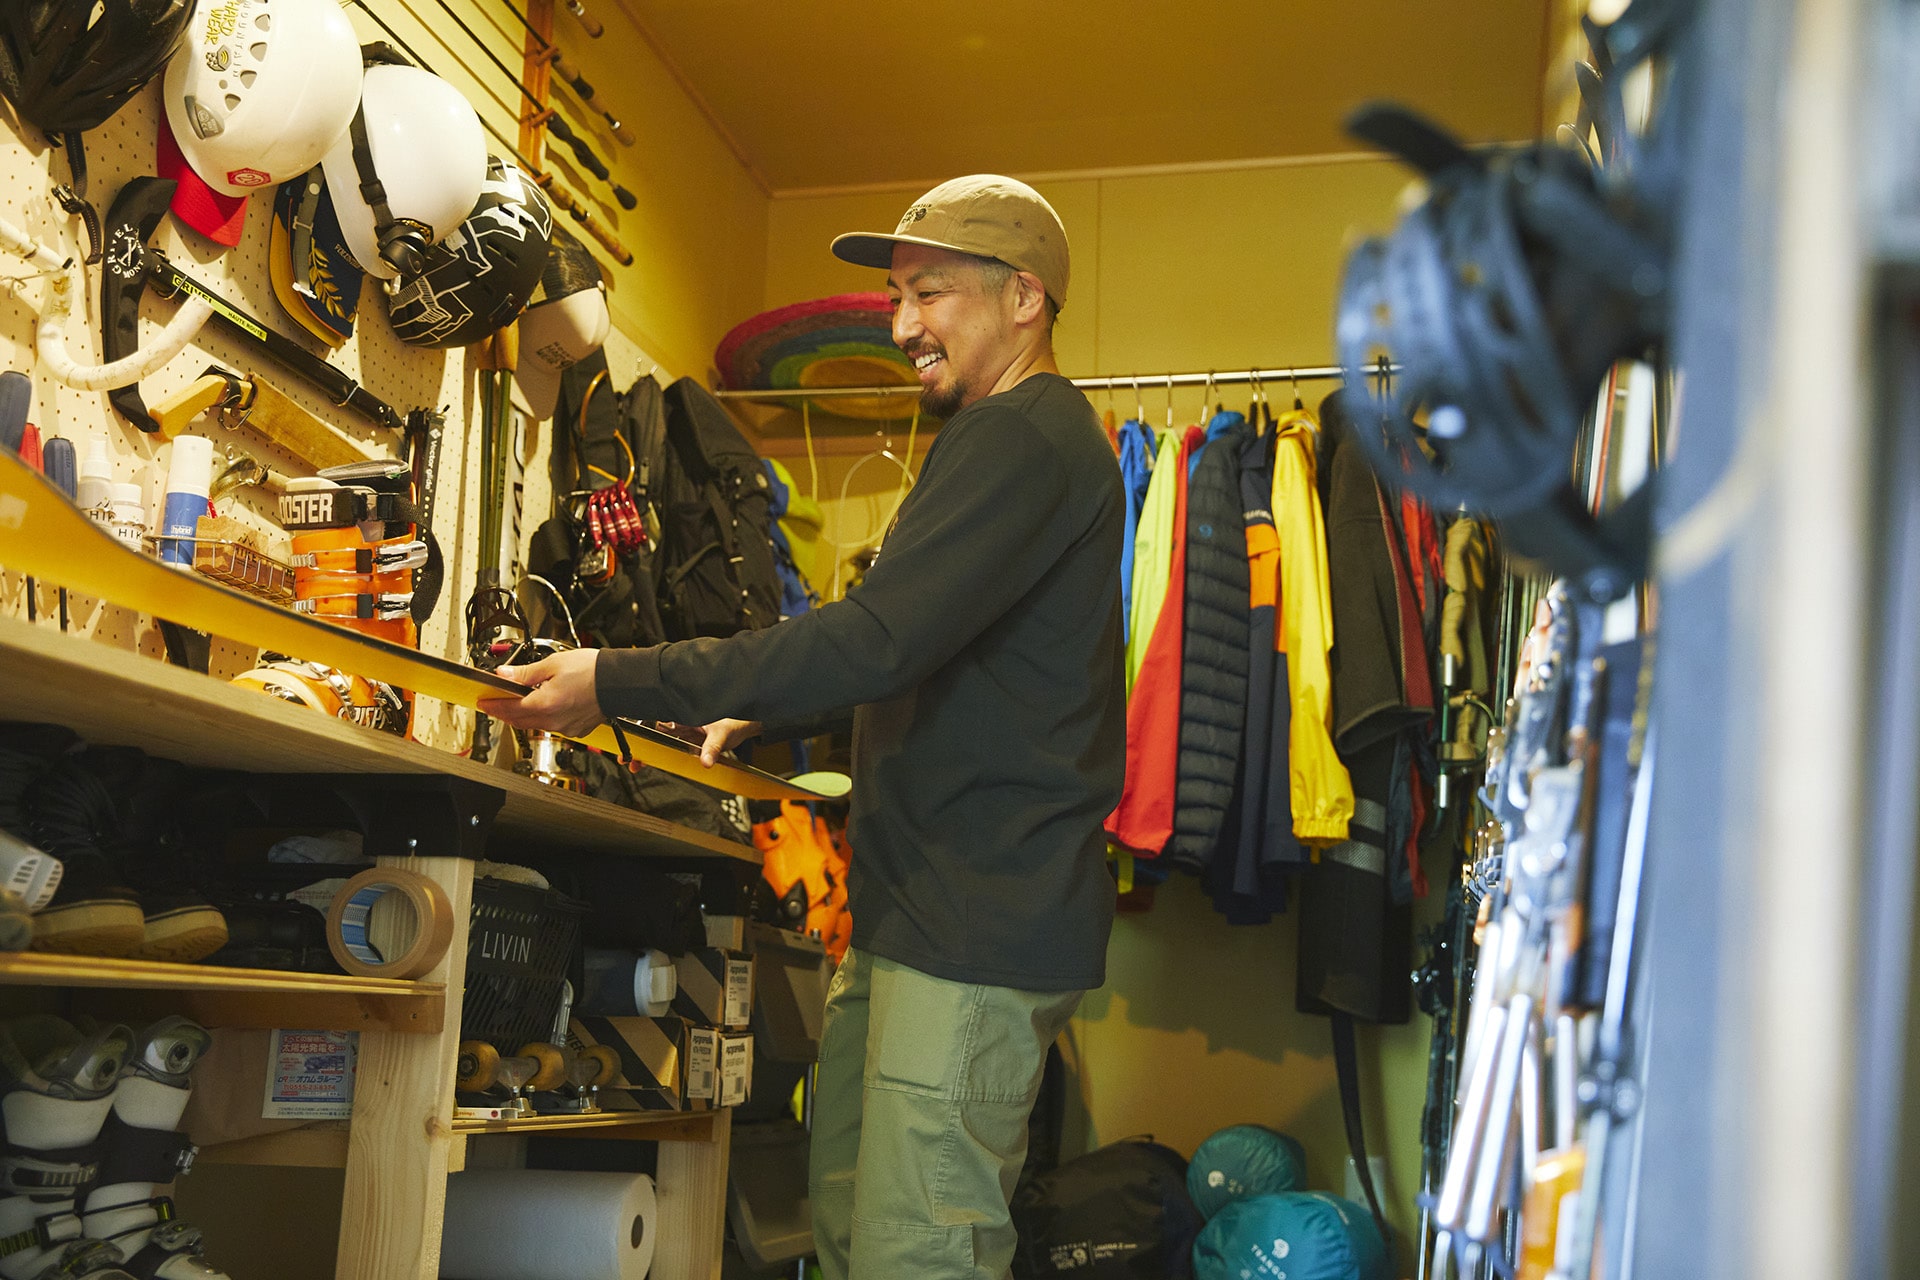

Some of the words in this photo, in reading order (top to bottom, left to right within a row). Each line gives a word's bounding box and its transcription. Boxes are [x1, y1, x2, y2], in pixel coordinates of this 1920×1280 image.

[203, 8, 224, 45] WEAR
[220, 0, 242, 36] HARD
[122, 259, 144, 279] MONT
[428, 440, 438, 469] Vector
[425, 469, 434, 489] glide
[481, 930, 532, 963] LIVIN
